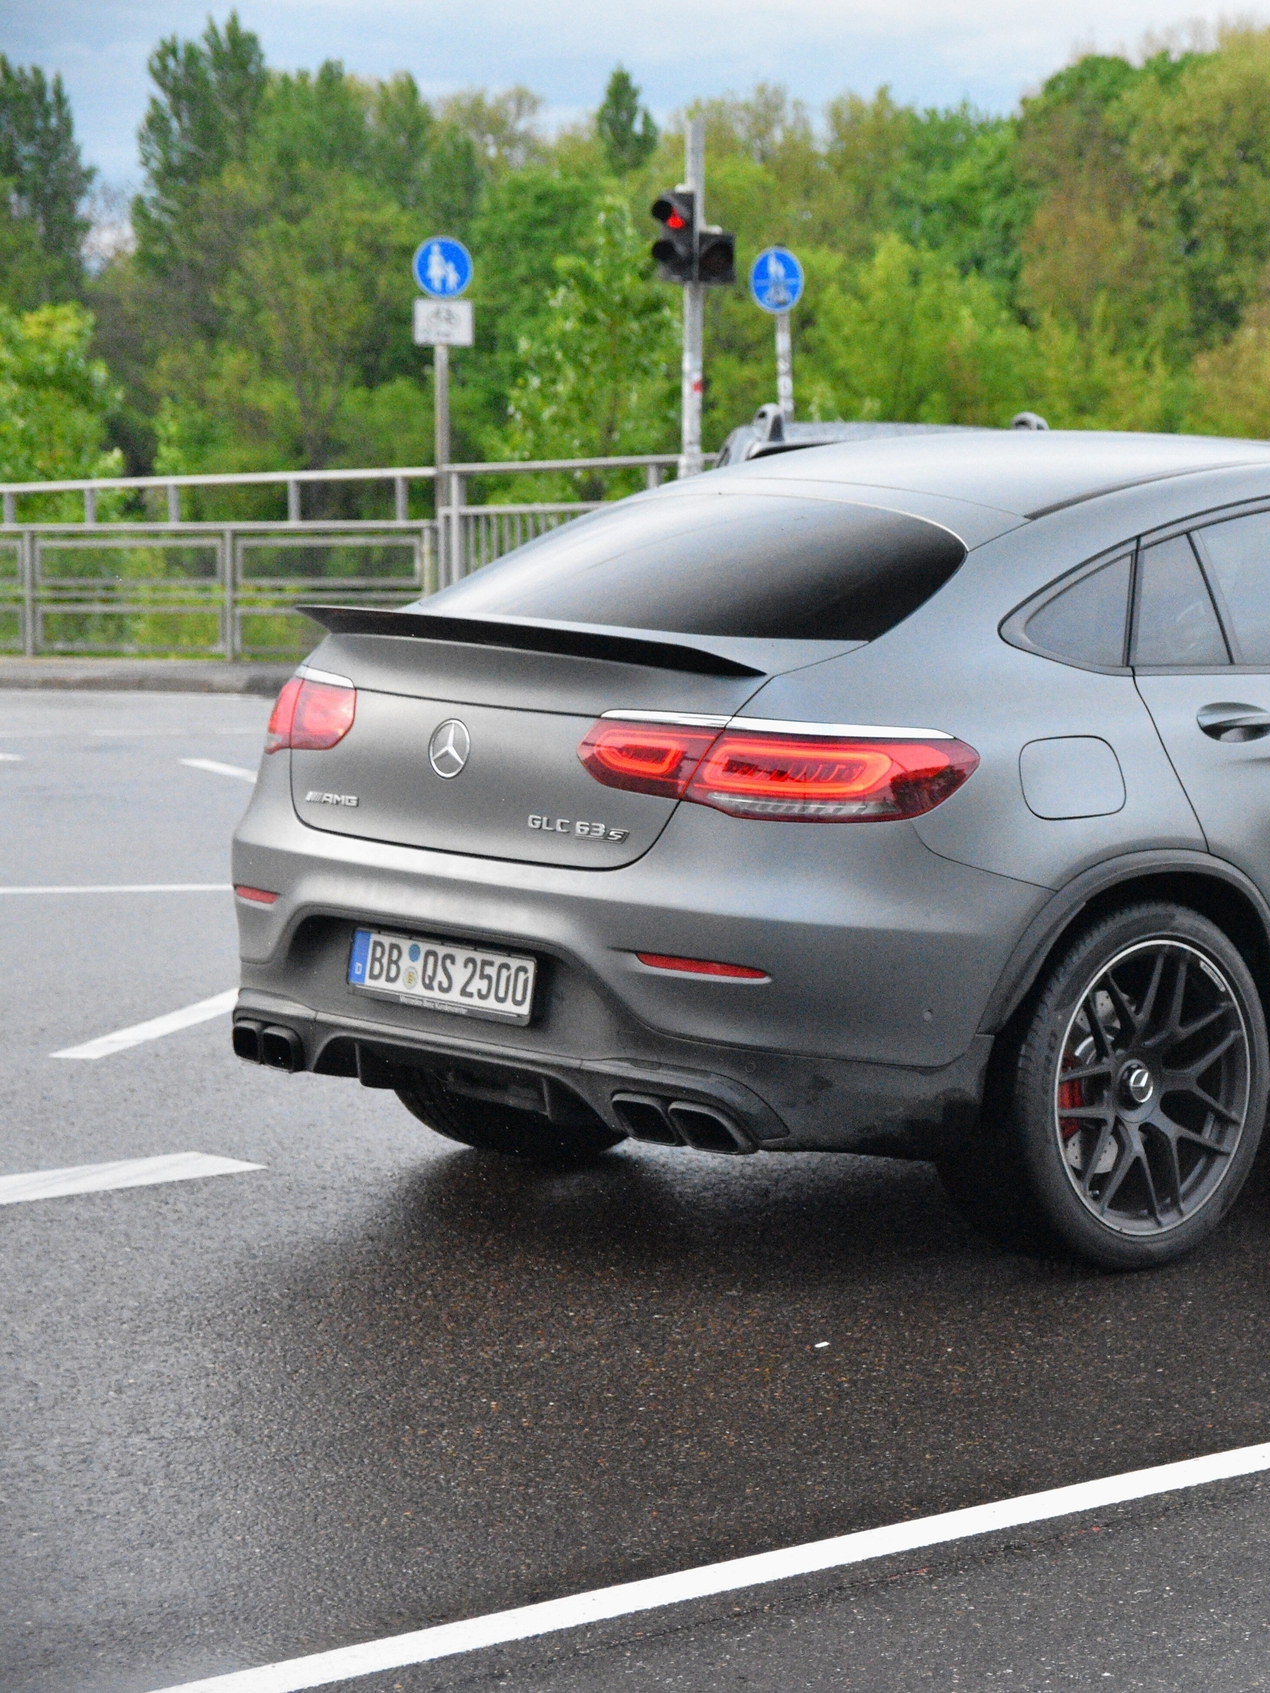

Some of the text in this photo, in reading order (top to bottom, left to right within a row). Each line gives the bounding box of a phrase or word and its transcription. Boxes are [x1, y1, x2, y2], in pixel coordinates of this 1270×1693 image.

[528, 814, 570, 833] GLC
[368, 940, 403, 983] BB
[421, 949, 456, 993] QS
[460, 957, 530, 1007] 2500
